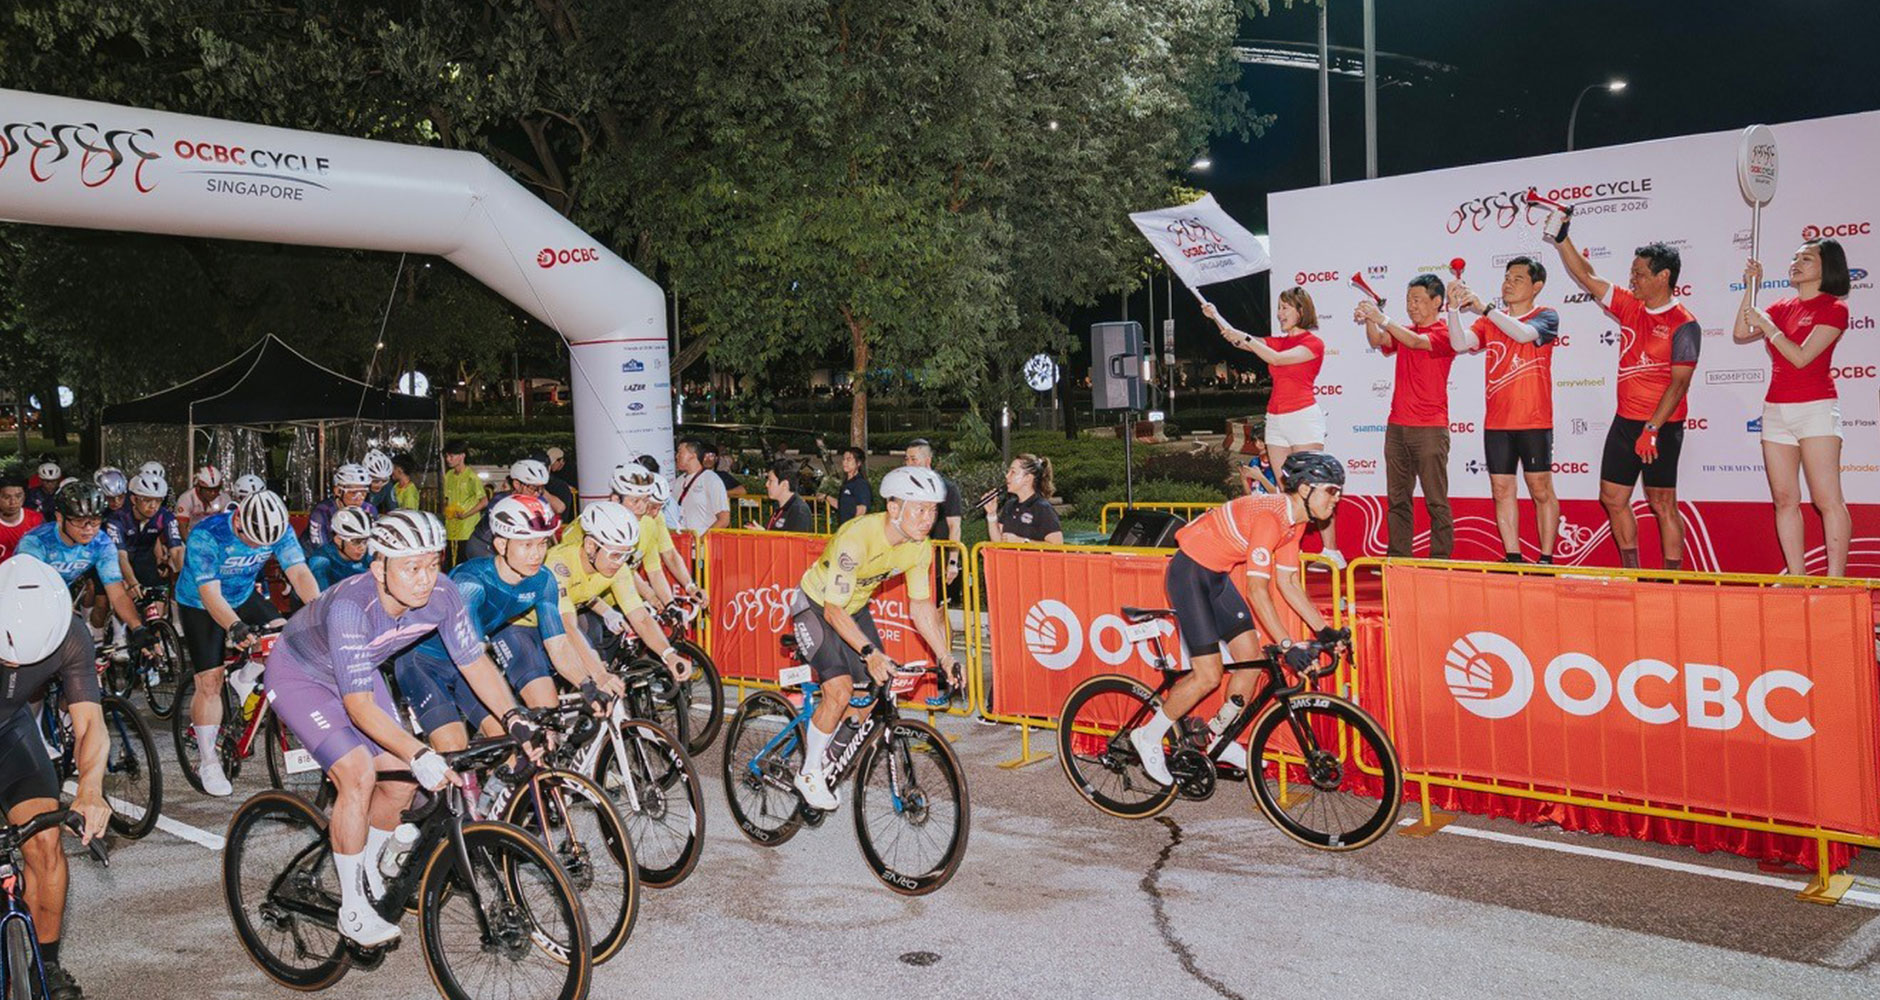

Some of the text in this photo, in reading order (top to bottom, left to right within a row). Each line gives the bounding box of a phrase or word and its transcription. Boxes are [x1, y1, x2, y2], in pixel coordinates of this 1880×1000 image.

[174, 140, 330, 176] OCBC CYCLE
[206, 178, 304, 201] SINGAPORE
[1548, 178, 1652, 201] OCBC CYCLE
[1572, 200, 1649, 217] GAPORE 2026
[1822, 222, 1871, 238] OCBC
[558, 248, 599, 264] OCBC
[1182, 244, 1207, 258] OCBC
[1309, 271, 1340, 283] OCBC
[1673, 285, 1692, 297] BC
[1553, 335, 1570, 347] BC
[1709, 372, 1761, 382] BROMPTON
[1831, 366, 1877, 380] OCBC
[624, 383, 647, 392] LAZER
[1313, 384, 1343, 395] OCBC
[1557, 377, 1605, 388] anywheel
[1450, 422, 1475, 434] CBC
[1347, 459, 1377, 470] Sport
[1550, 462, 1589, 474] OCBC
[868, 598, 909, 619] CYCL
[1544, 652, 1816, 740] OCBC
[893, 725, 931, 741] DRIVE
[827, 713, 875, 787] S-WORKS
[741, 821, 770, 841] DRIVE
[883, 871, 919, 891] DRIVE
